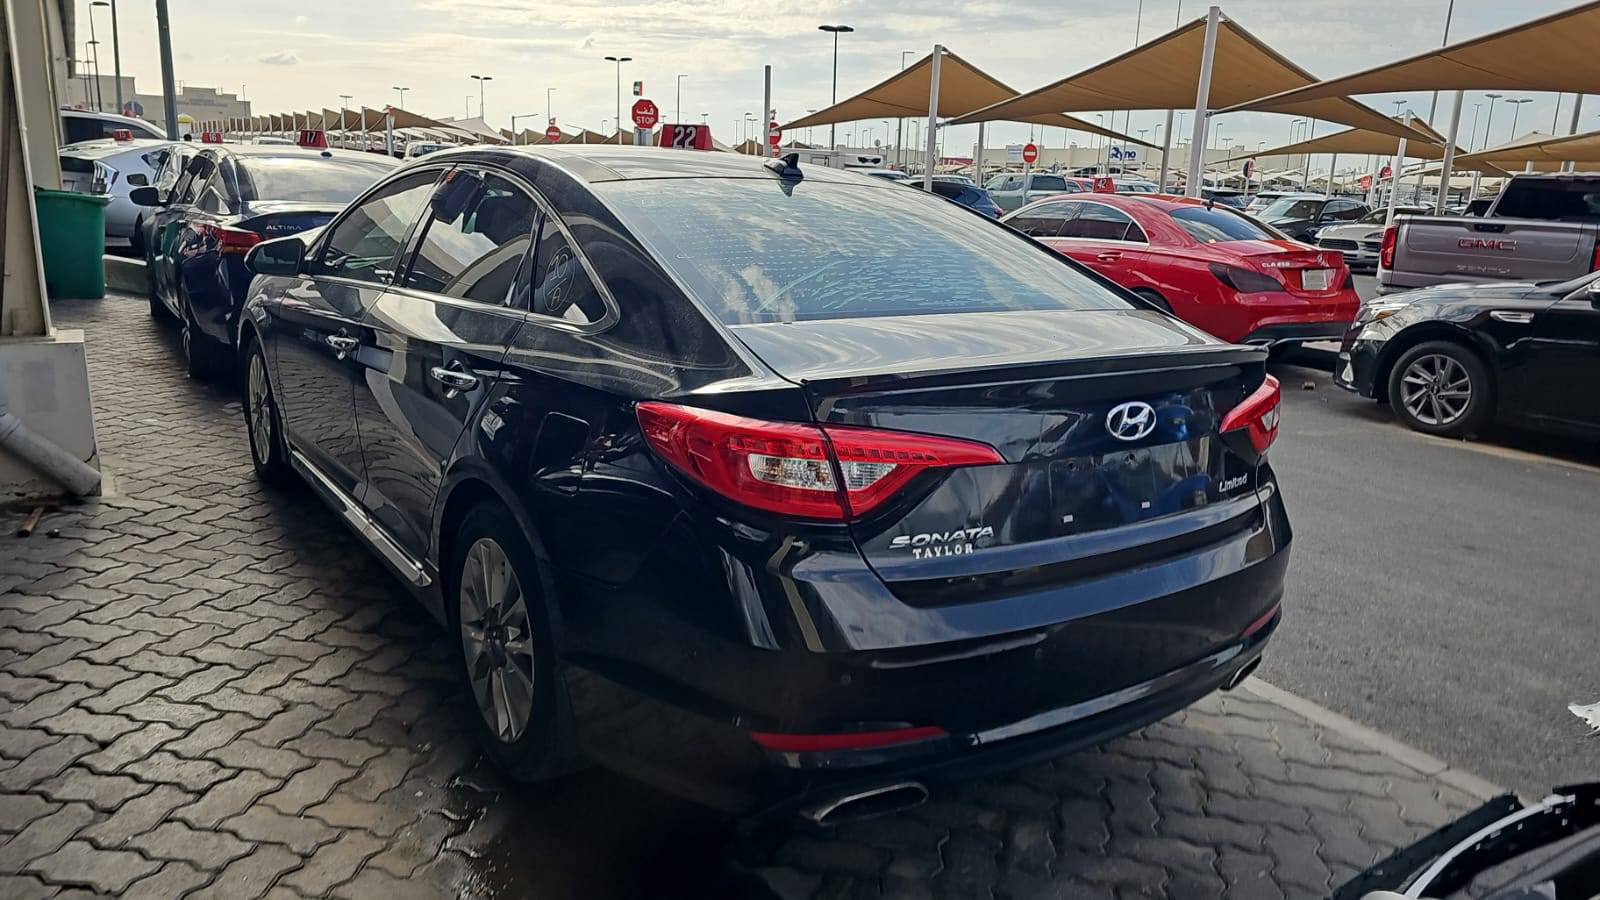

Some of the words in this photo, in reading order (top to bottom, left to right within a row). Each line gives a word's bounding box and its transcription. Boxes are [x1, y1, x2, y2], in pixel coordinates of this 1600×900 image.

[636, 104, 654, 115] قف
[636, 116, 655, 124] STOP
[306, 131, 316, 144] 17
[673, 126, 697, 149] 22
[1457, 237, 1517, 251] GMC
[1218, 472, 1248, 493] Limited
[888, 526, 994, 549] SONATA
[912, 543, 974, 560] TAYLOR
